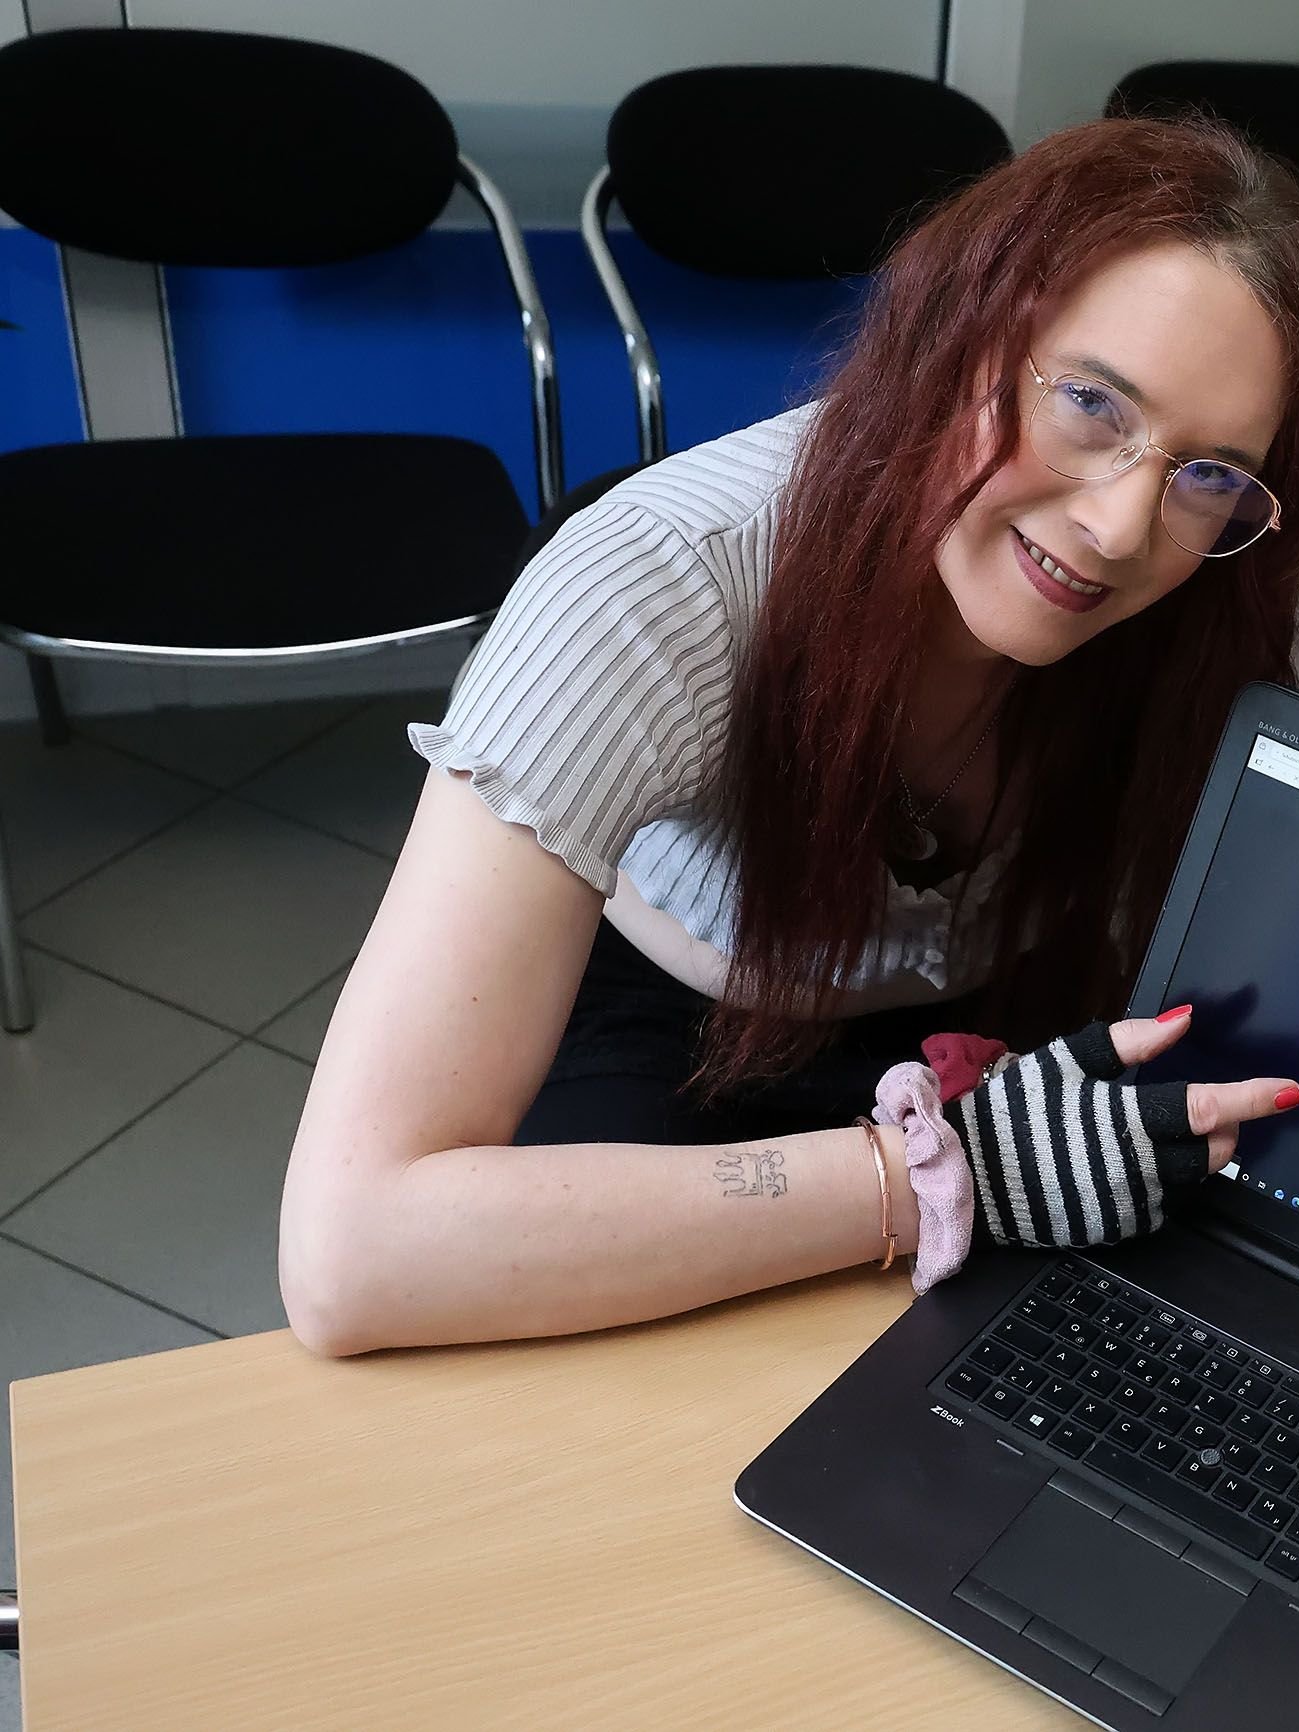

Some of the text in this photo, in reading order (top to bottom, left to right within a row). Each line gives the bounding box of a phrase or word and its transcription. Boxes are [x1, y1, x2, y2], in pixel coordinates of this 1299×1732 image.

[1258, 721, 1280, 735] BANG
[1071, 1324, 1080, 1332] Q
[1105, 1341, 1117, 1351] W
[1056, 1352, 1065, 1361] A
[1137, 1359, 1146, 1368] E
[1090, 1370, 1099, 1378] S
[1170, 1377, 1180, 1386] R
[1053, 1385, 1062, 1393] Y
[1124, 1388, 1134, 1397] D
[1207, 1395, 1215, 1403] T
[1085, 1403, 1096, 1412] X
[930, 1405, 965, 1428] ZBook
[1241, 1414, 1251, 1423] Z
[1121, 1423, 1131, 1432] C
[1194, 1426, 1204, 1435] G
[1277, 1433, 1286, 1442] U
[1158, 1441, 1167, 1450] V
[1229, 1444, 1240, 1454] H
[1190, 1462, 1199, 1471] B
[1226, 1481, 1237, 1490] N
[1263, 1500, 1275, 1511] M
